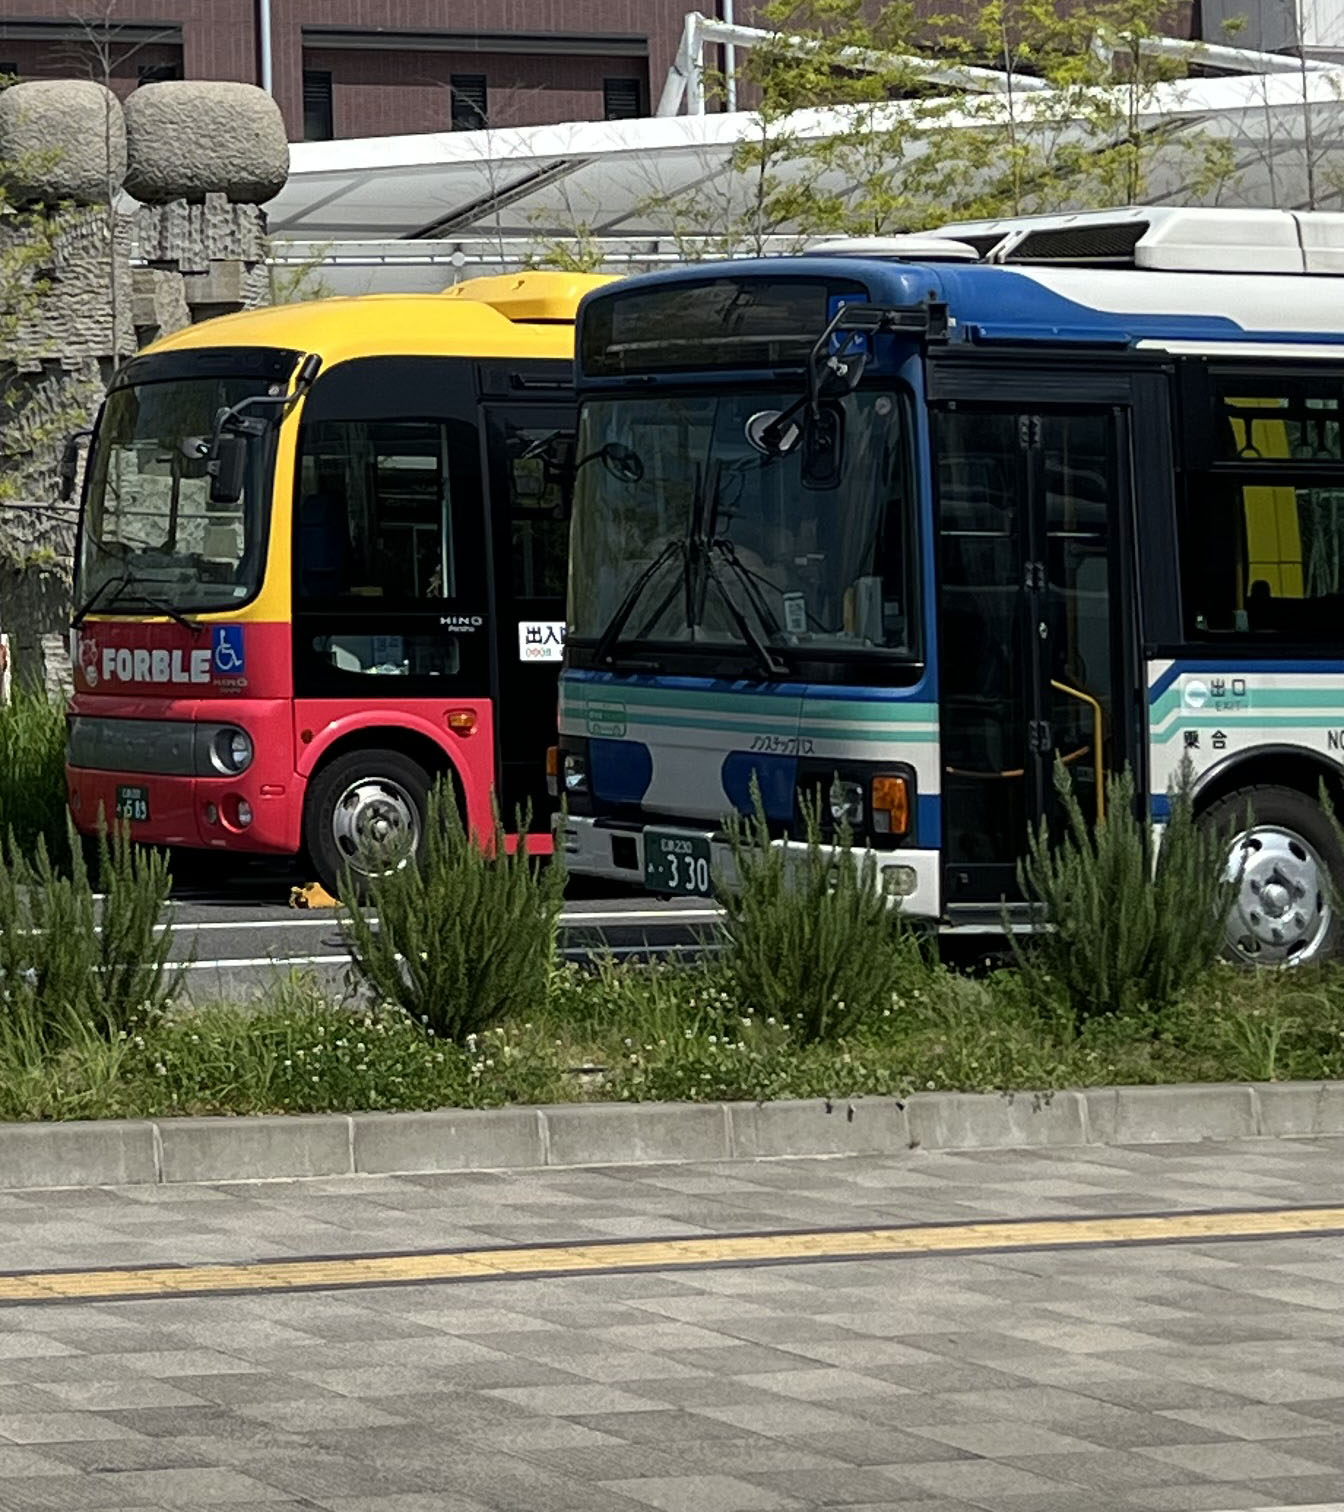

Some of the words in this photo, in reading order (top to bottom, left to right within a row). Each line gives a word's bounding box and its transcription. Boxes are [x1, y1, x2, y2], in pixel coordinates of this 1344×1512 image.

[440, 616, 483, 626] HINO
[102, 648, 212, 683] FORBLE
[1211, 678, 1246, 698] 出口
